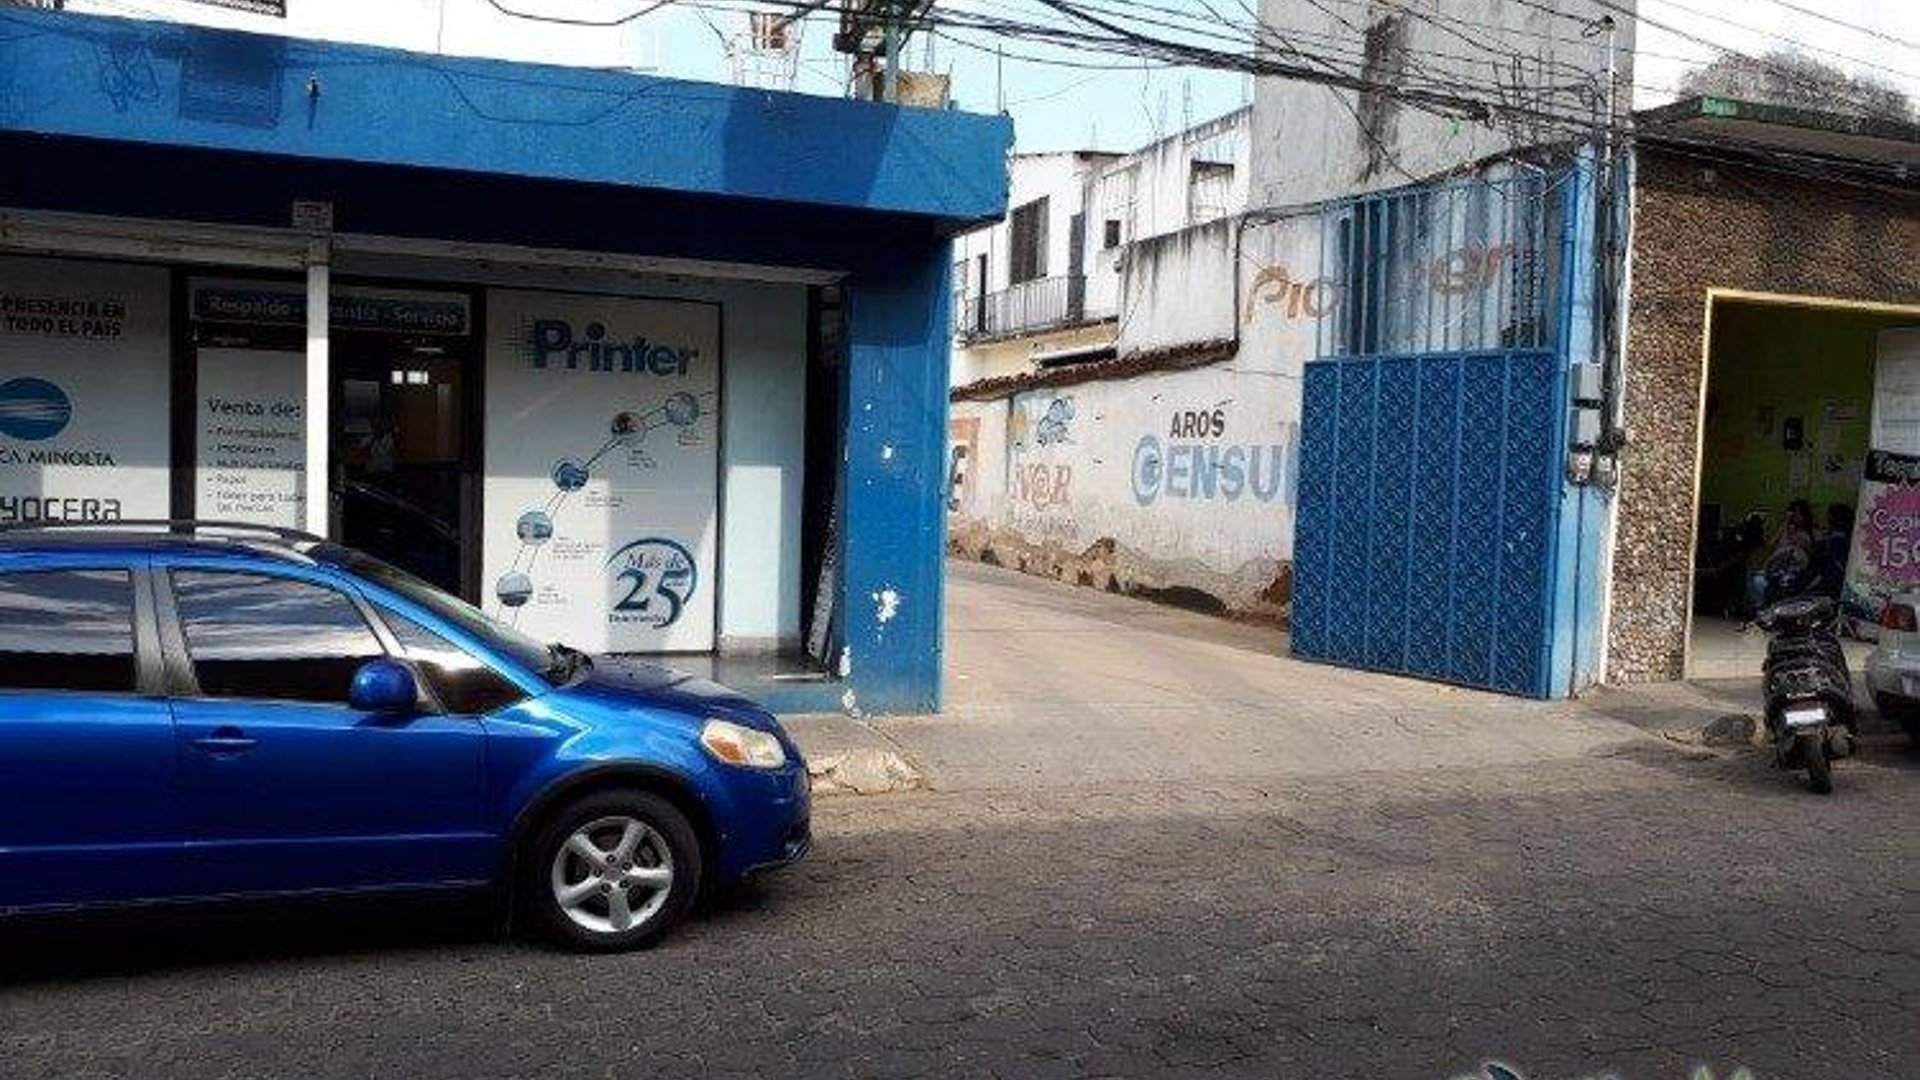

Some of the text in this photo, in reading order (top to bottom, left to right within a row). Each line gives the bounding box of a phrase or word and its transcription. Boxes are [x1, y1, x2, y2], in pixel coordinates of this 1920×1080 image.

[7, 317, 54, 333] TODO
[59, 318, 78, 334] EL
[528, 318, 699, 377] Printer
[208, 399, 301, 419] Venta de:
[1169, 408, 1226, 439] AROS
[27, 449, 117, 467] MINOLTA
[613, 567, 690, 629] 25
